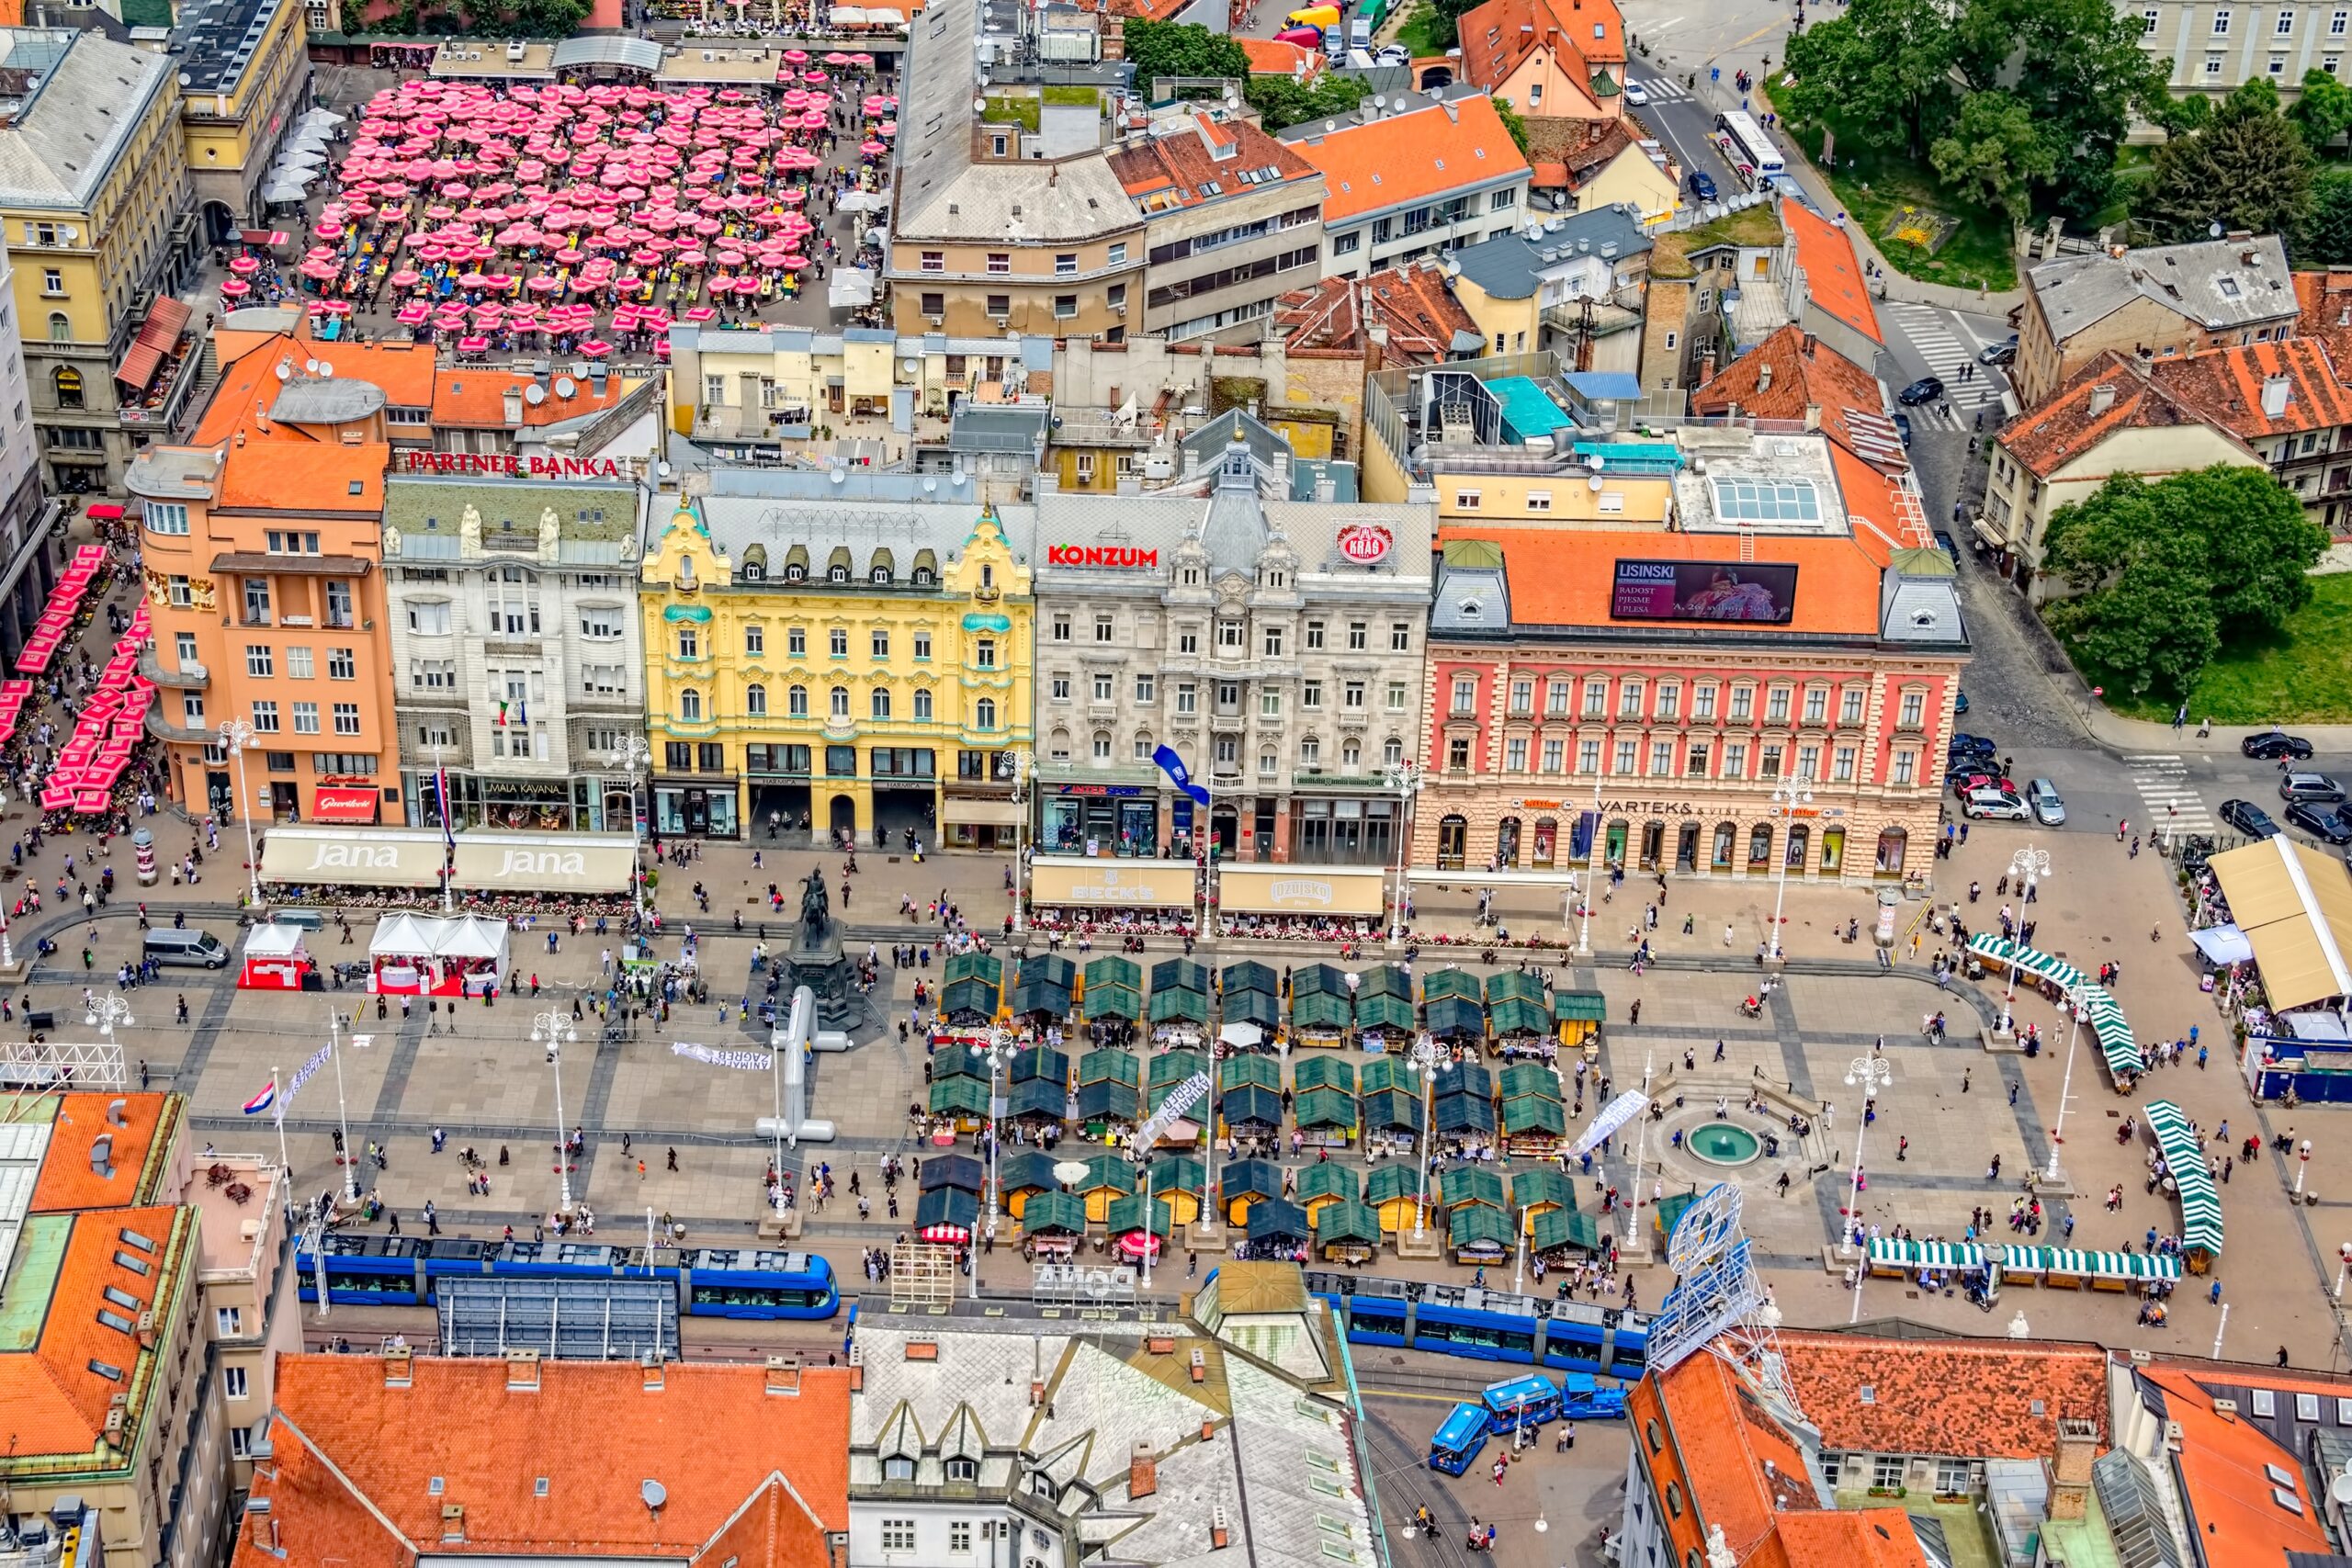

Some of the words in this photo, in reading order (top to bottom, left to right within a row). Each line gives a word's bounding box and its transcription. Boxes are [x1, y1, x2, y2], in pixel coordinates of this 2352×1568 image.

[409, 452, 519, 474] PARTNER
[530, 457, 618, 477] BANKA
[1048, 545, 1158, 568] KONZUM
[1619, 564, 1674, 578] LISINSKI
[490, 783, 517, 793] MALA
[520, 784, 560, 795] KAVANA
[1071, 886, 1155, 900] BECK'S
[718, 1051, 769, 1062] ZAGREB
[1163, 1079, 1210, 1126] ANIMAFEST
